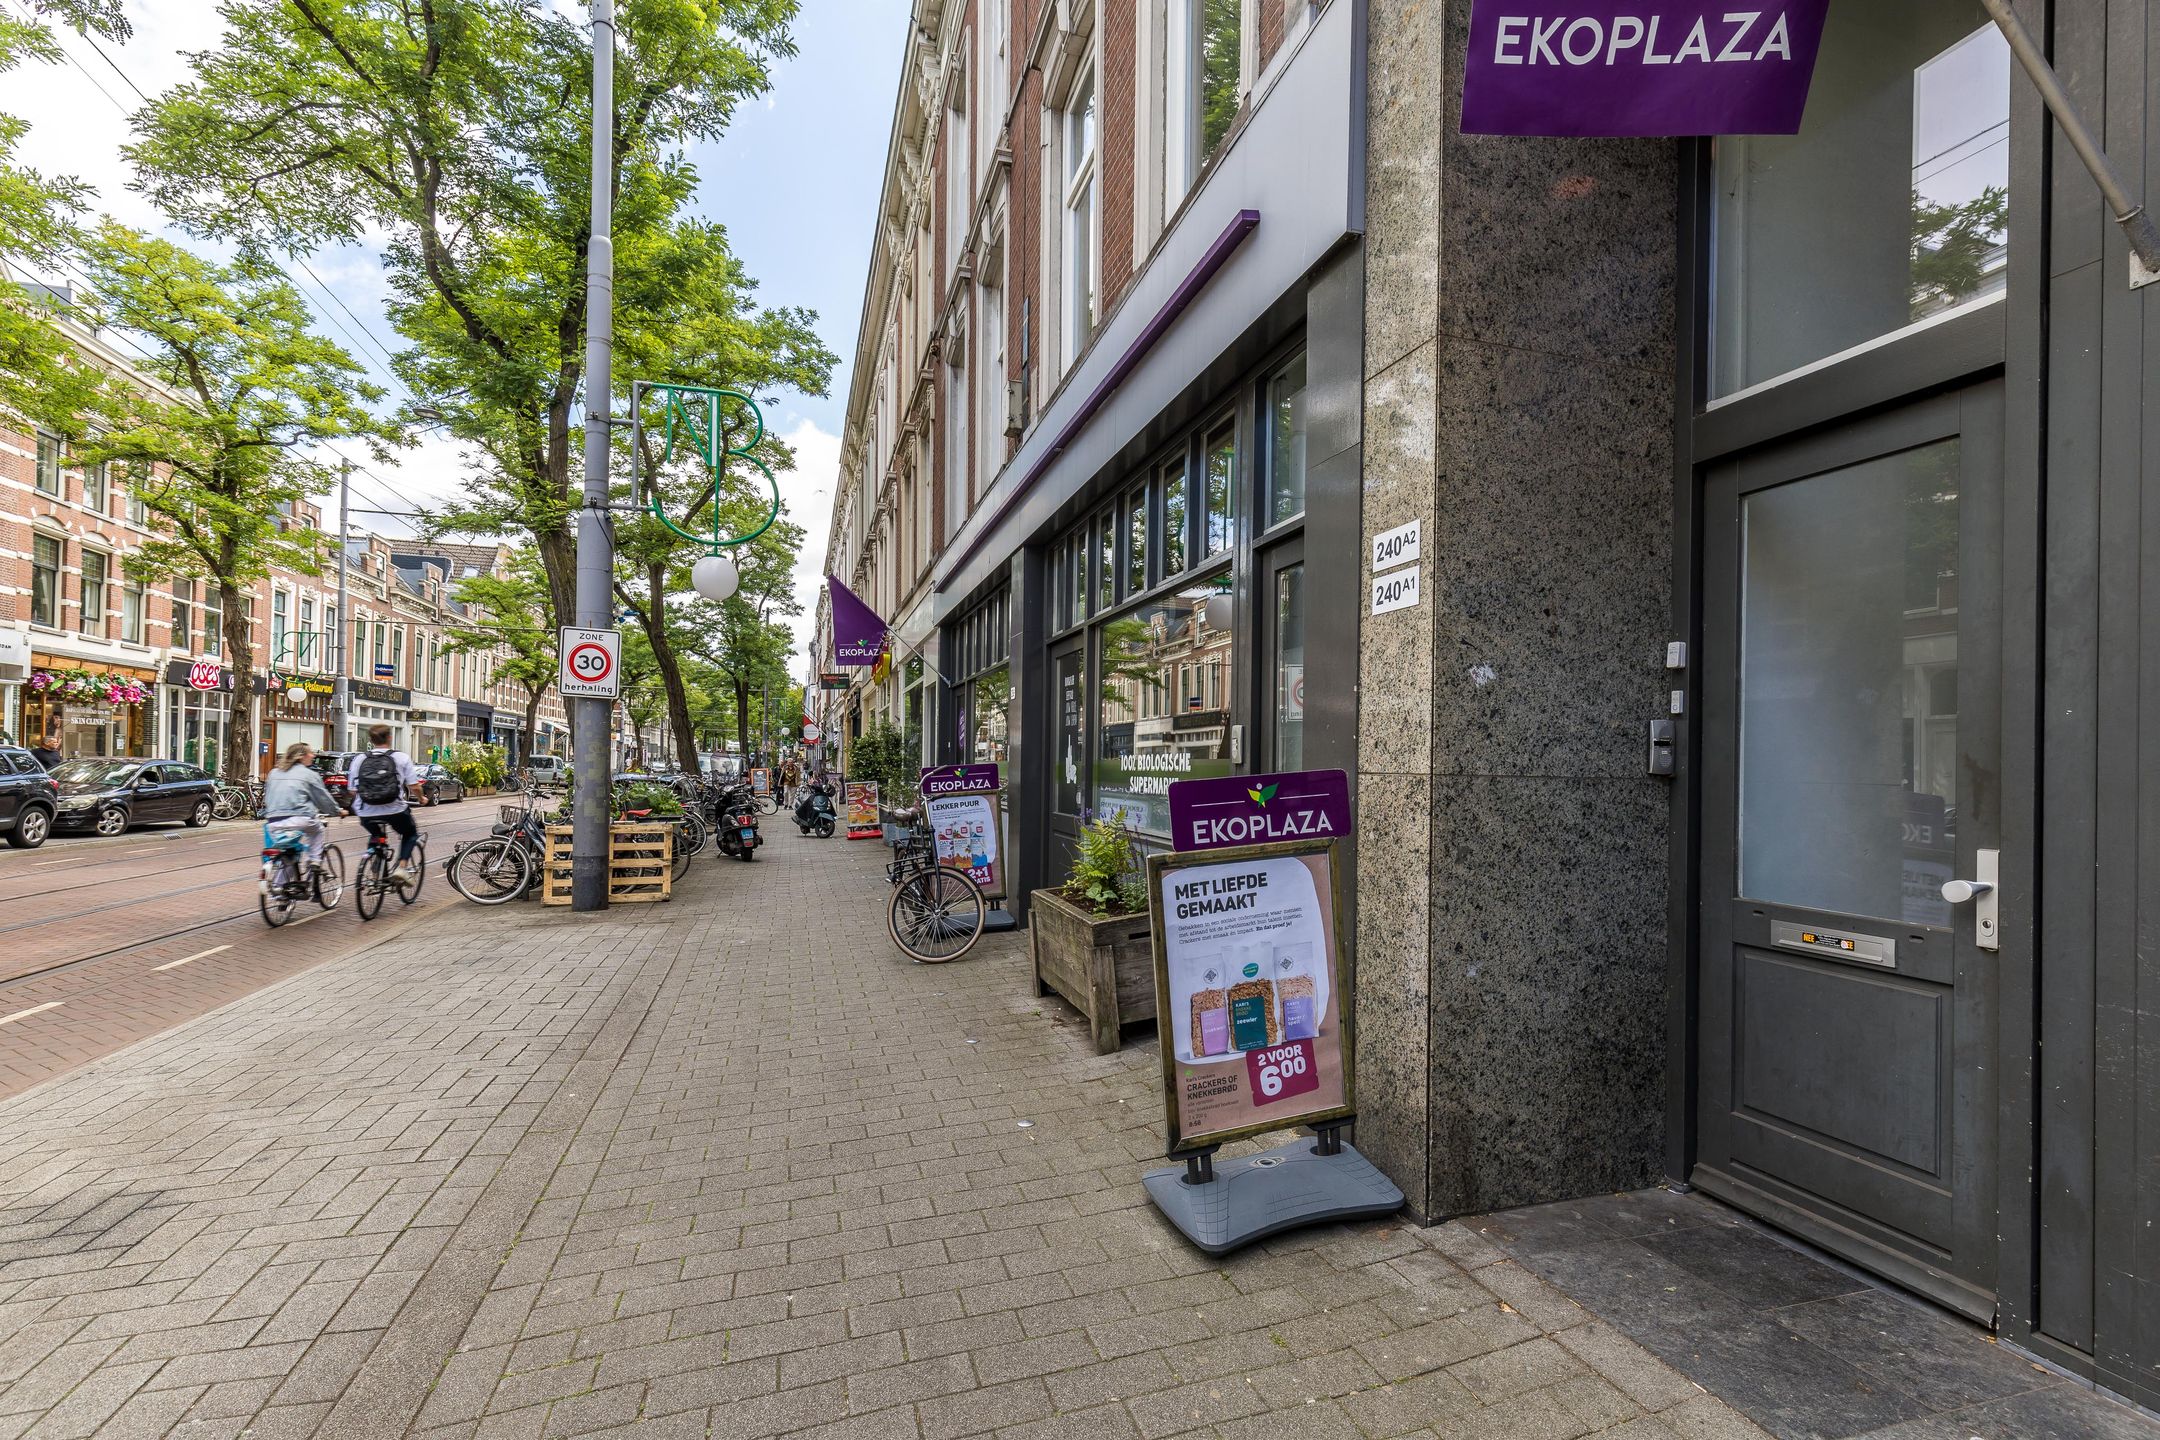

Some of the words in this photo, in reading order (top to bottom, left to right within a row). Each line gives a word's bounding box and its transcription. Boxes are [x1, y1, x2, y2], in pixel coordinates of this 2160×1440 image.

[1494, 11, 1791, 66] EKOPLAZA
[580, 633, 604, 641] ZONE
[576, 655, 604, 671] 30
[564, 683, 613, 694] herhaling
[1138, 753, 1191, 772] BIOLOGISCHE
[930, 779, 991, 792] EKOPLAZA
[932, 802, 959, 811] LEKKER
[1193, 810, 1333, 844] EKOPLAZA
[968, 866, 988, 878] 2+1
[1175, 881, 1210, 900] MET
[1212, 872, 1268, 894] LIEFDE
[1177, 892, 1257, 919] GEMAAKT
[1803, 934, 1814, 943] NEE
[1257, 1054, 1267, 1066] 2
[1267, 1044, 1302, 1063] VOOR
[1187, 1077, 1227, 1092] CRACKERS
[1228, 1075, 1238, 1084] OF
[1187, 1084, 1238, 1100] KNEKKEBRØD
